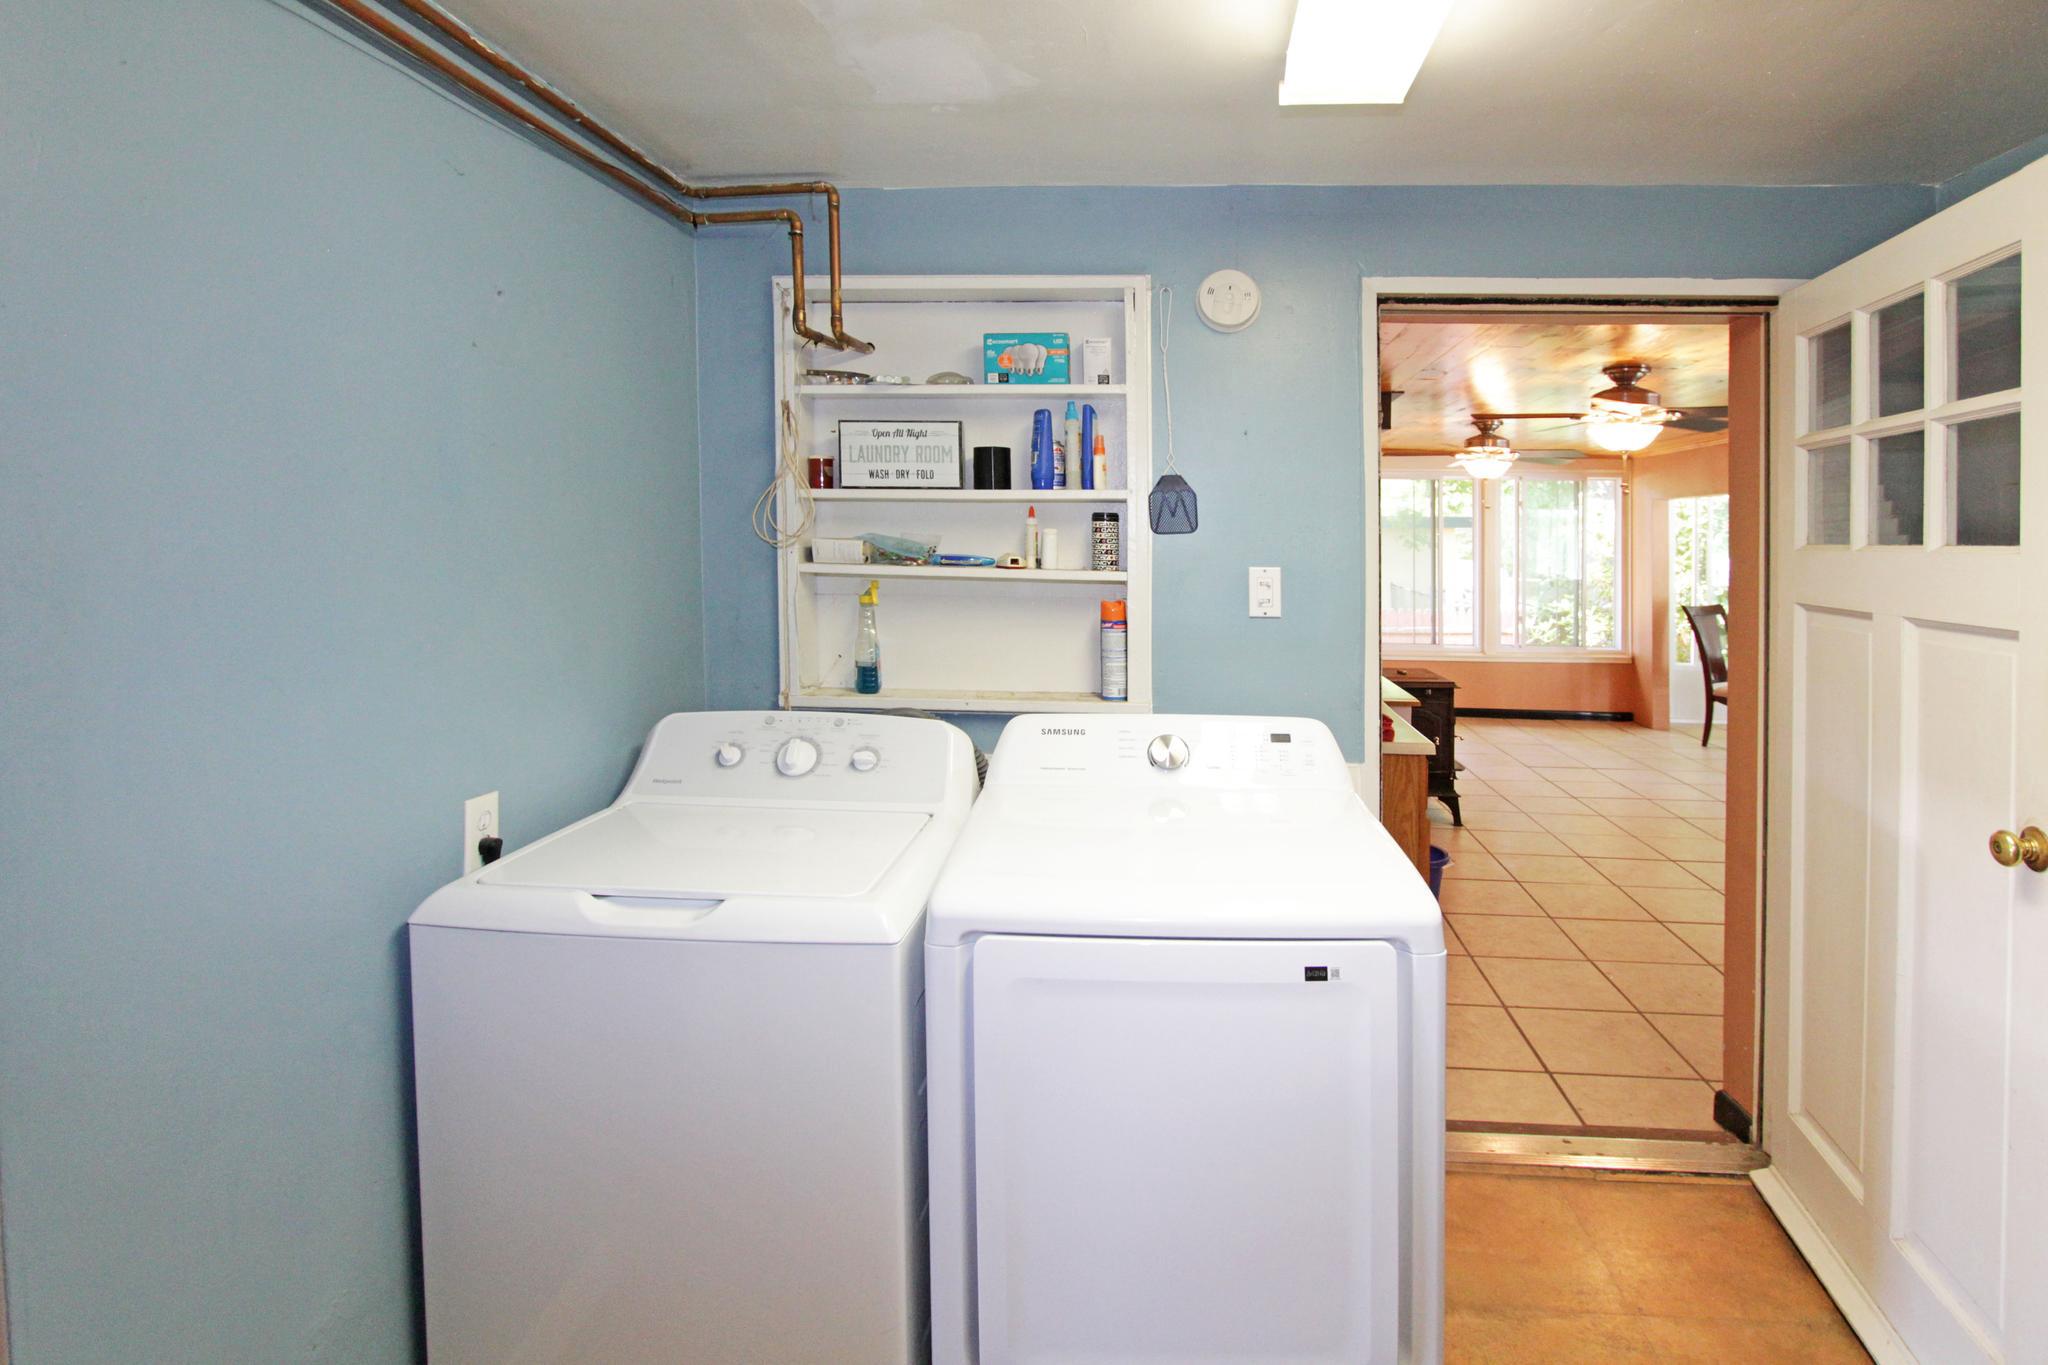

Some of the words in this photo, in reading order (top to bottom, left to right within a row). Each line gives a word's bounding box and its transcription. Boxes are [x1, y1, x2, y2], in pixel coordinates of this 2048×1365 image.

[872, 428, 891, 440] Open
[893, 428, 904, 438] All
[906, 428, 928, 440] Night
[849, 445, 910, 463] LAUNDRY
[915, 445, 953, 463] ROOM
[868, 469, 890, 479] WASH
[895, 469, 910, 479] DRY
[916, 469, 935, 480] FOLD
[1040, 728, 1087, 736] SAMSUNG
